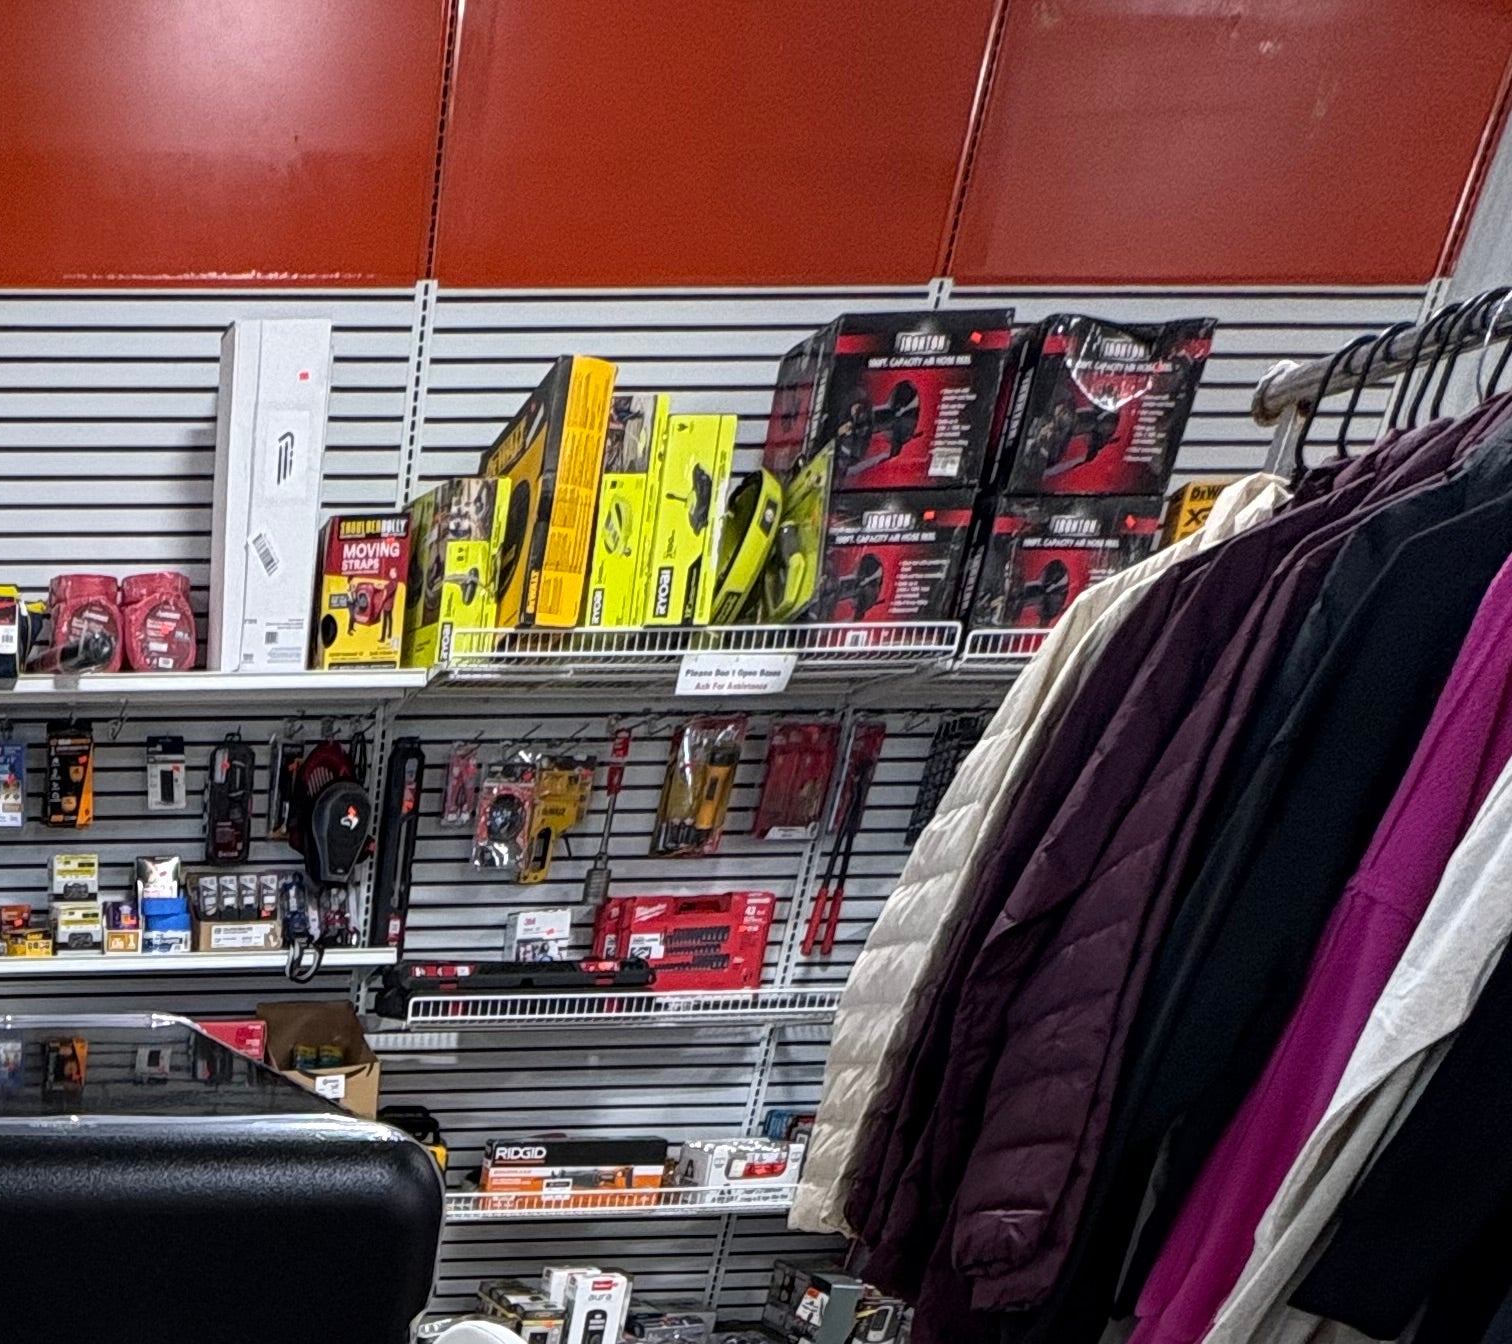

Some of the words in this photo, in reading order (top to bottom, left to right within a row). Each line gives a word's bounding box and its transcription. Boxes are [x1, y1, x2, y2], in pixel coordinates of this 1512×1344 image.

[899, 335, 946, 352] IRONTON
[889, 357, 922, 368] CAPACITY
[936, 355, 955, 366] HOSE
[856, 534, 889, 544] CAPACITY
[901, 532, 920, 542] HOSE
[343, 543, 400, 559] MOVING
[341, 559, 380, 571] STRAPS
[655, 568, 672, 617] RYOBI
[592, 590, 603, 624] RYOBI
[685, 669, 713, 677] Please
[737, 669, 758, 679] Open
[695, 682, 709, 690] Ask
[712, 682, 725, 690] For
[727, 682, 767, 690] Assistance
[495, 1147, 547, 1160] RIDGID
[588, 1293, 612, 1301] aura
